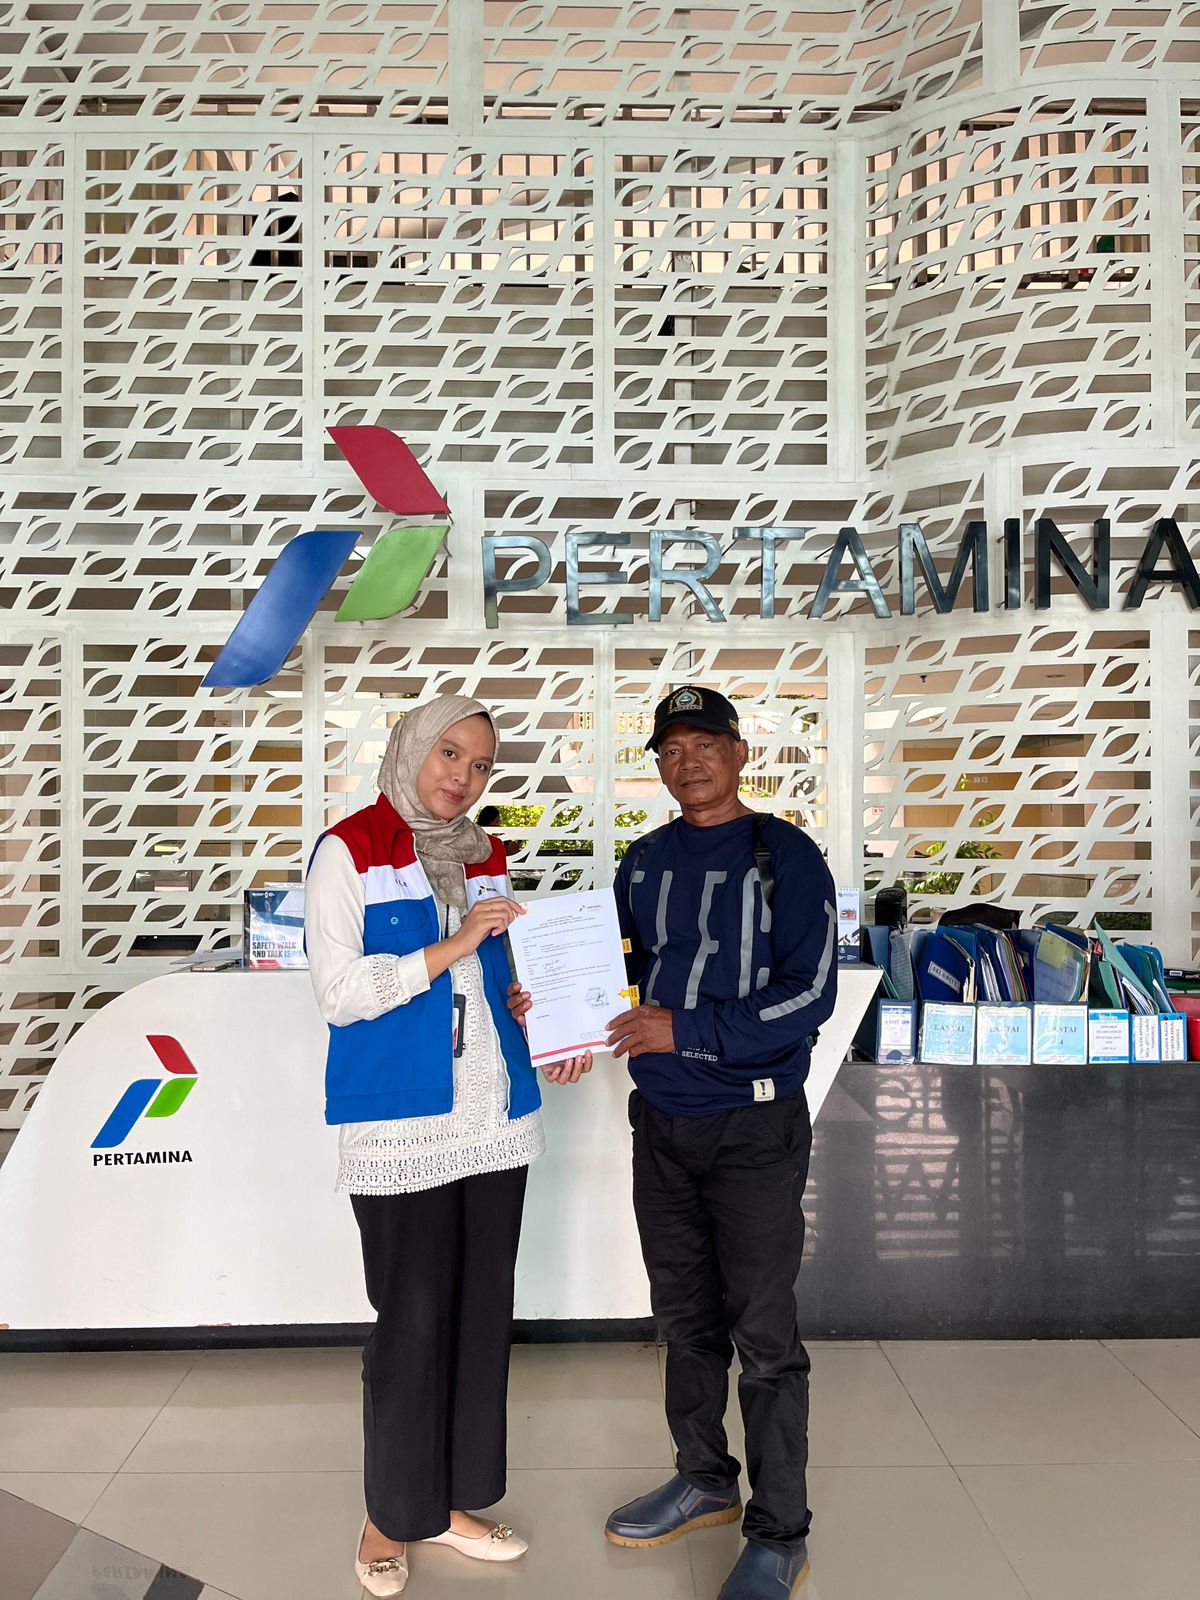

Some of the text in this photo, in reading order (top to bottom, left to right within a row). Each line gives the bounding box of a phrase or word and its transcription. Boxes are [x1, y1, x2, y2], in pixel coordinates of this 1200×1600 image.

[481, 517, 1200, 630] PERTAMINA
[252, 941, 297, 949] SAFETY WALK
[252, 950, 265, 958] AND
[267, 950, 283, 958] TALK
[681, 1050, 718, 1062] SELECTED
[93, 1150, 193, 1167] PERTAMINA
